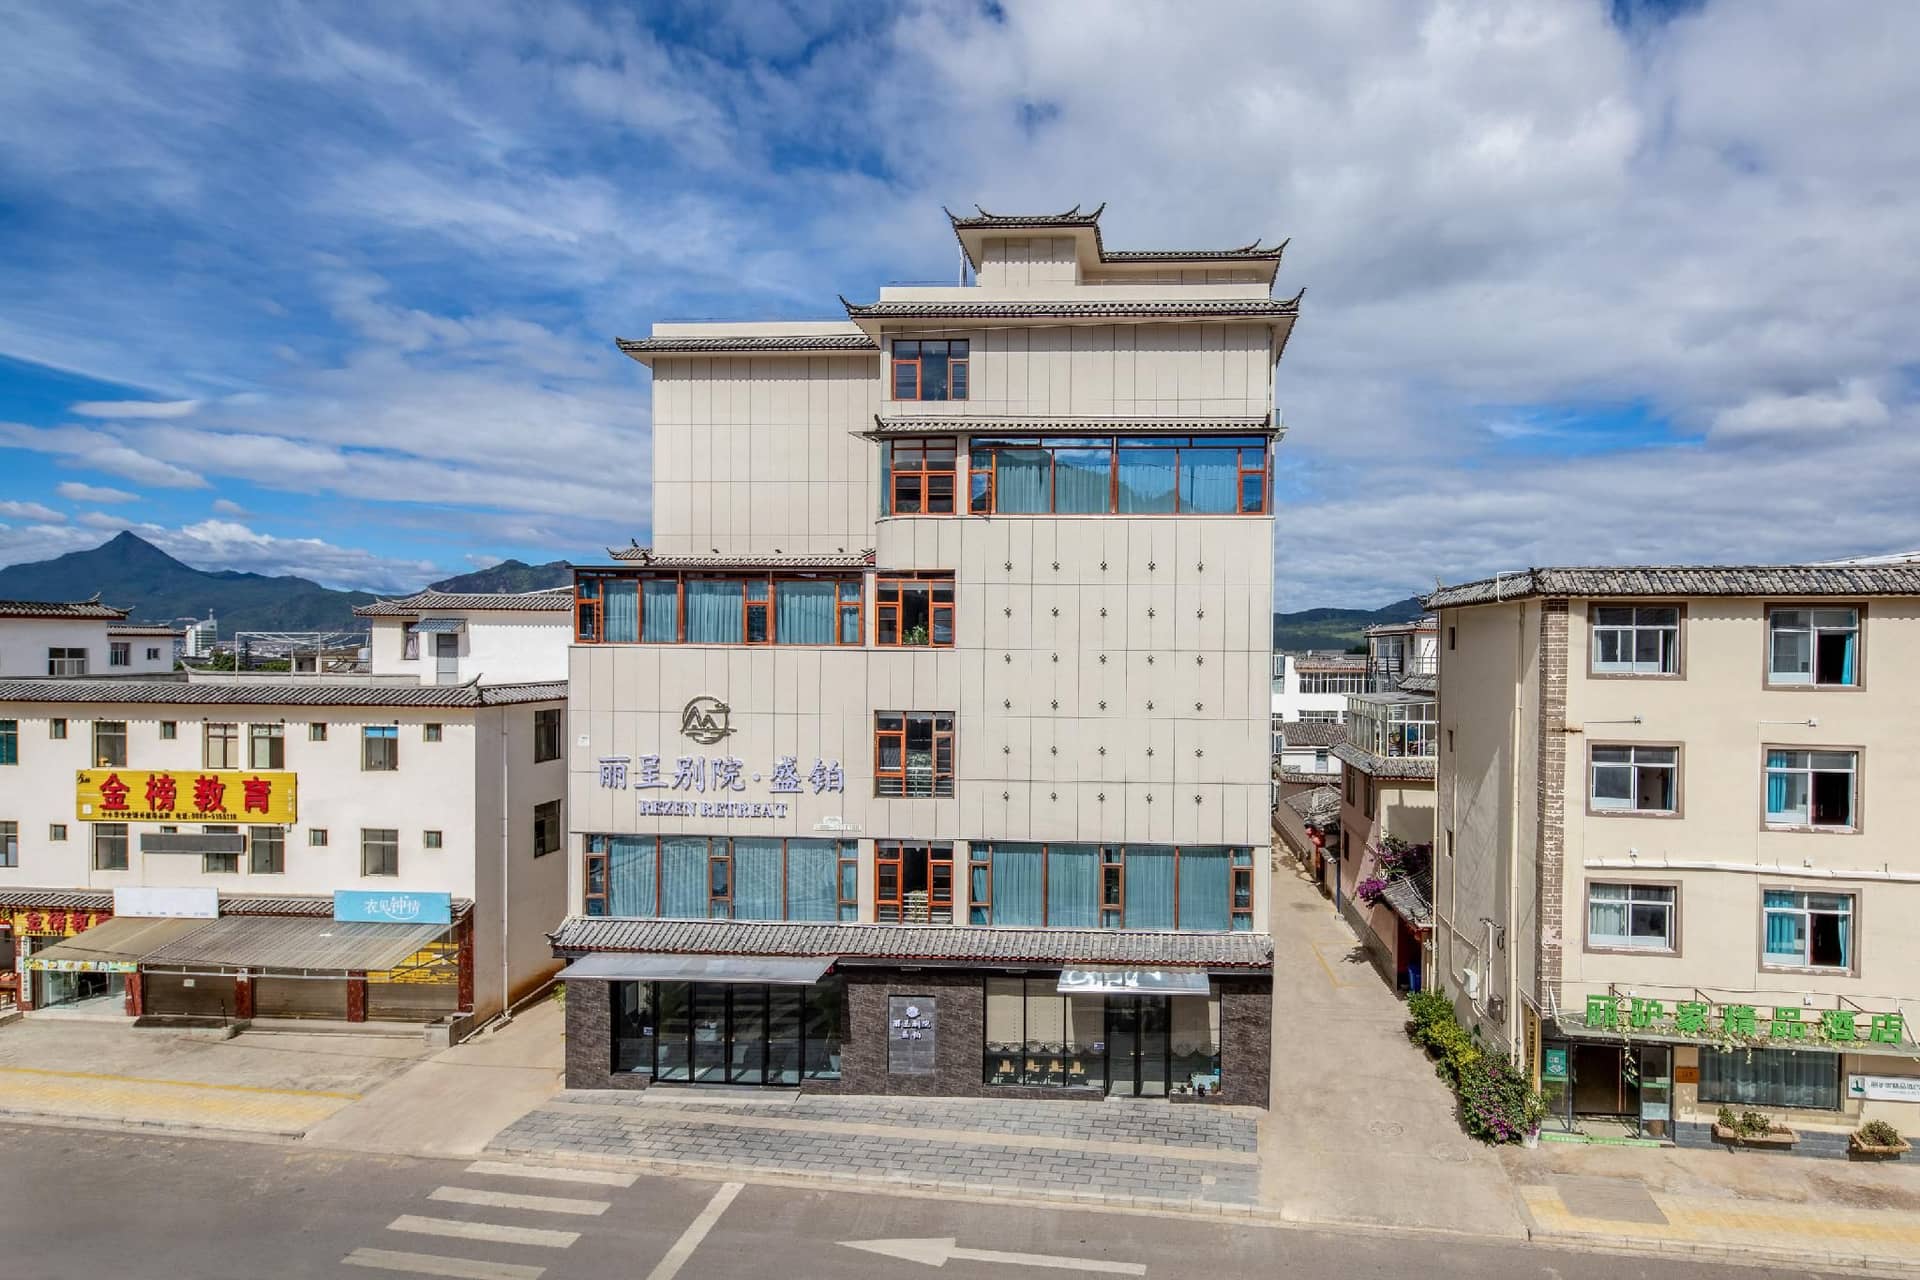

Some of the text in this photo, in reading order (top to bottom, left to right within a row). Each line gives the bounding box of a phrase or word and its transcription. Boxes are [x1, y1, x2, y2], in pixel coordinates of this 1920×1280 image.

[99, 772, 271, 814] 金榜教育
[639, 801, 788, 818] REZEN RETREAT
[364, 895, 421, 915] 衣见钟情
